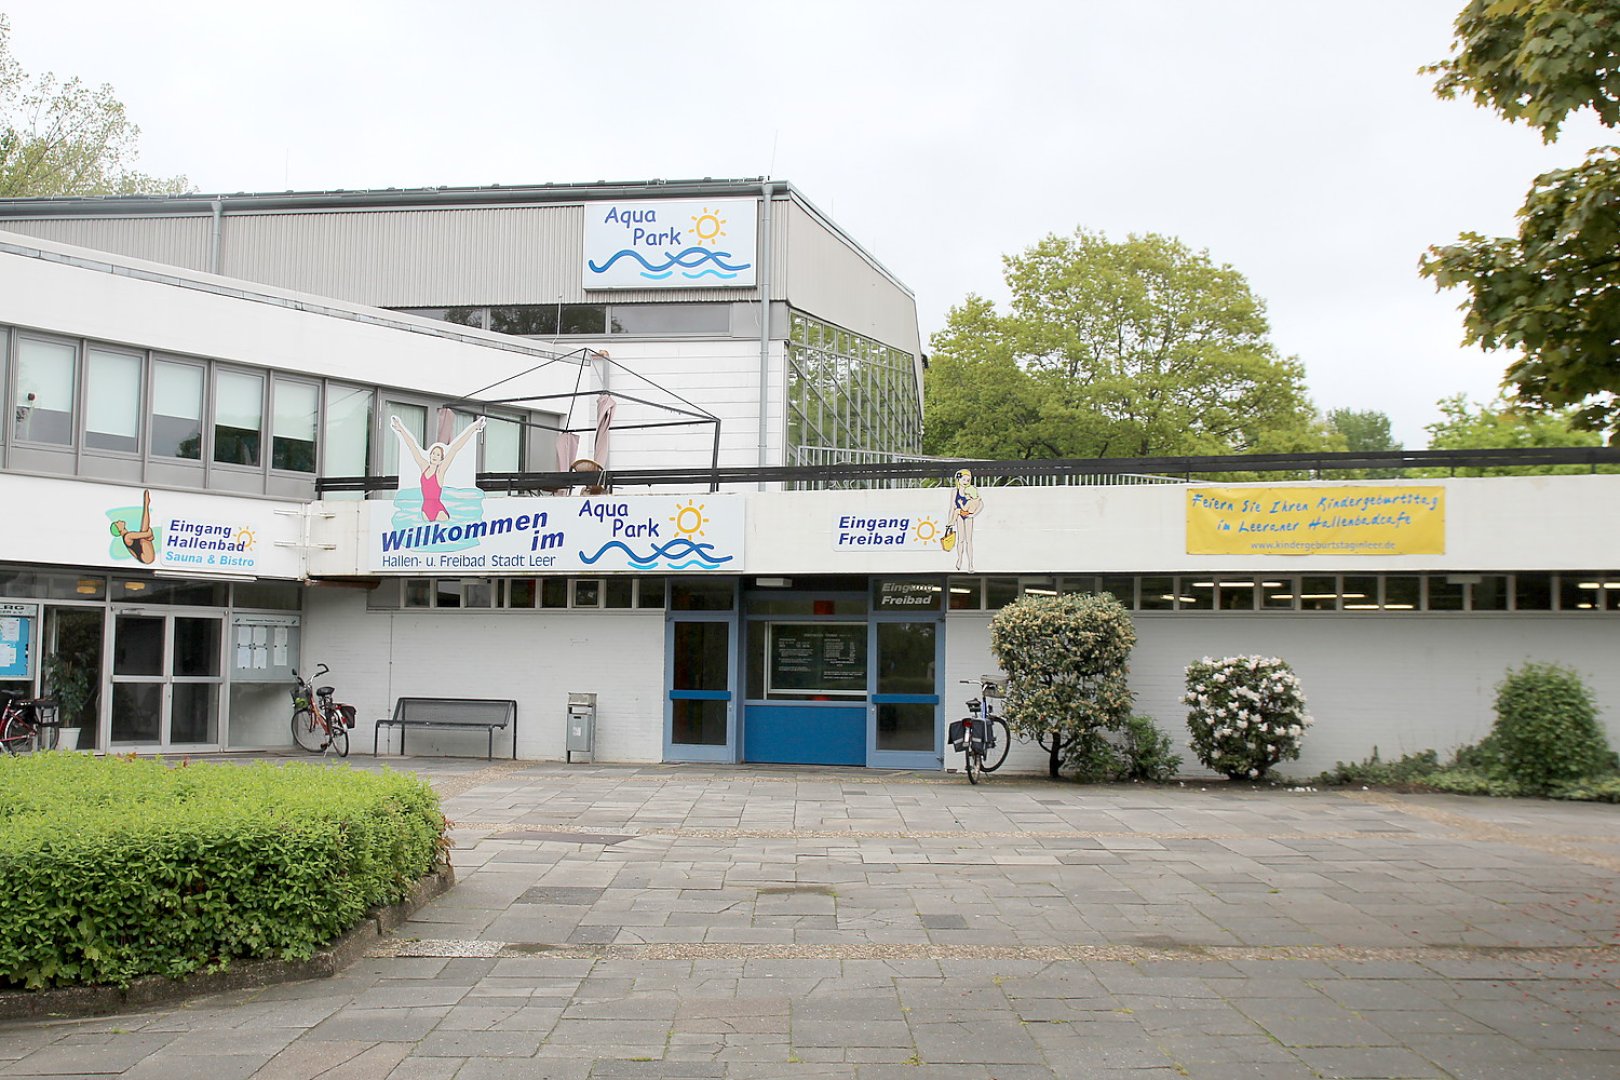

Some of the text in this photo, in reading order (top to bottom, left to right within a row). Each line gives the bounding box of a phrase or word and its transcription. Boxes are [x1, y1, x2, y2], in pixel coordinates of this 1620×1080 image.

[604, 206, 657, 229] Aqua
[632, 226, 682, 247] Park
[578, 499, 629, 523] Aqua
[1192, 493, 1438, 514] Feiern Sie Ihren Kindergeburtstag
[170, 519, 232, 539] Eingang
[382, 511, 549, 552] Willkommen
[612, 517, 660, 538] Park
[839, 516, 910, 531] Eingang
[167, 535, 246, 552] Hallenbad
[531, 529, 565, 551] im
[839, 532, 906, 545] Freibad
[165, 551, 255, 567] Sauna & Bistro
[382, 555, 556, 567] Hallen- u. Freibad Stadt Leer
[881, 595, 932, 605] Freibad
